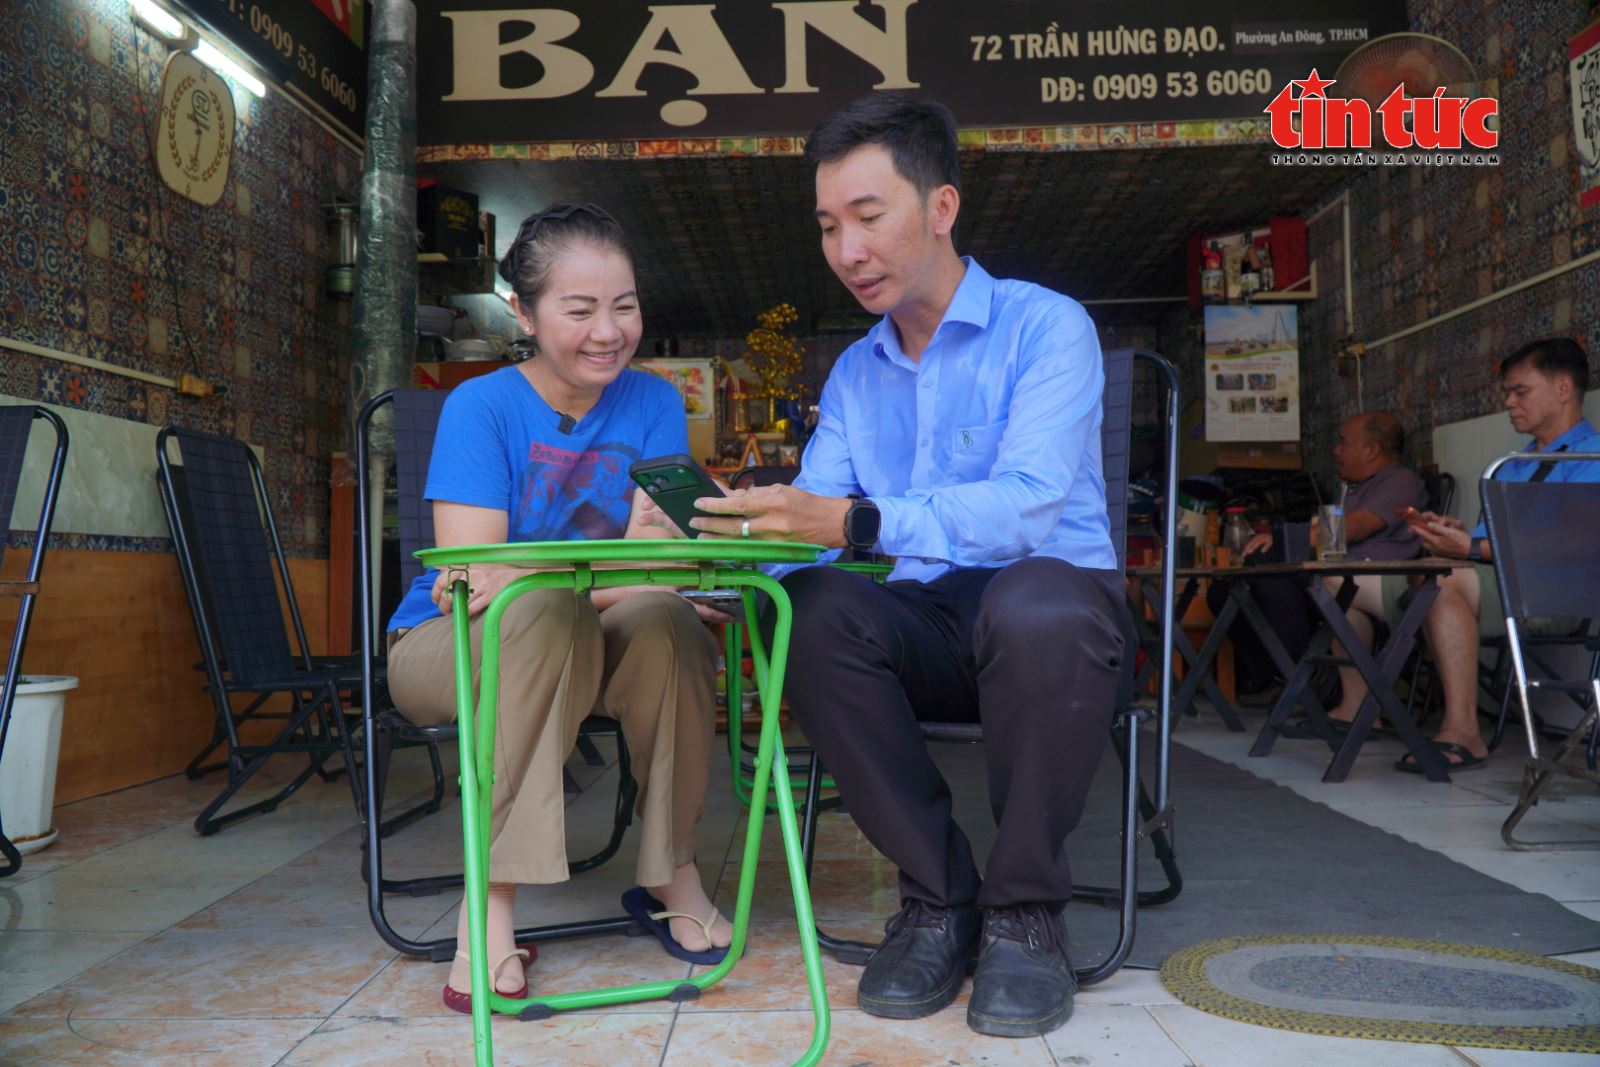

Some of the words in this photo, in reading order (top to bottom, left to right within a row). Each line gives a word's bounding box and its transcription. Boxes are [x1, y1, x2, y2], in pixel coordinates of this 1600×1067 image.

[970, 35, 1002, 61] 72
[1009, 21, 1079, 59] TRẦN
[1087, 25, 1157, 56] HƯNG
[1164, 26, 1226, 57] ĐẠO.
[1235, 30, 1278, 46] Phường
[1279, 31, 1293, 43] An
[1329, 28, 1368, 41] TP.HCM
[250, 5, 293, 57] 0909
[298, 43, 316, 79] 53
[321, 66, 356, 112] 6060
[441, 0, 920, 126] BẠN
[1041, 76, 1085, 103] DĐ:
[1093, 73, 1158, 101] 0909
[1166, 71, 1198, 98] 53
[1206, 68, 1272, 96] 6060
